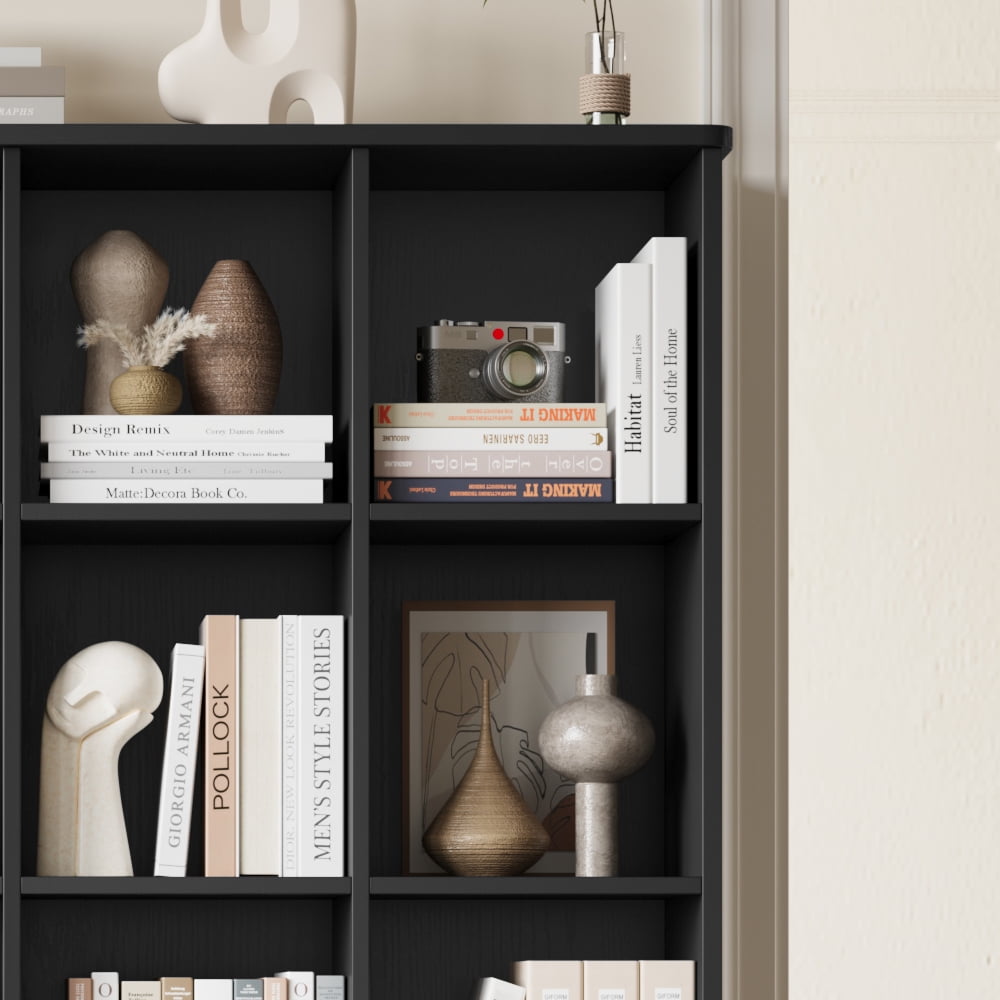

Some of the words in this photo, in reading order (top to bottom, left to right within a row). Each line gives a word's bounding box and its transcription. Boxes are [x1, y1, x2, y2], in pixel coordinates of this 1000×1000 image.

[633, 334, 642, 354] Liess
[664, 328, 678, 370] Home
[633, 355, 642, 385] Lauren
[664, 372, 678, 388] the
[664, 389, 678, 404] of
[520, 408, 536, 421] IT
[538, 408, 596, 421] MAKING
[624, 393, 642, 453] Habitat
[664, 406, 678, 434] Soul
[71, 423, 121, 437] Design
[126, 423, 171, 435] Remix
[482, 433, 525, 444] SAARINEN
[527, 433, 549, 444] EERO
[68, 449, 91, 457] The
[94, 449, 130, 457] White
[133, 449, 153, 457] and
[156, 449, 198, 457] Neutral
[201, 449, 235, 457] Home
[549, 456, 604, 471] Over
[191, 487, 223, 499] Book
[227, 487, 247, 499] Co.
[523, 483, 539, 497] IT
[542, 483, 602, 497] MAKING
[285, 623, 295, 729] REVOLUTION
[313, 627, 332, 717] STORIES
[175, 677, 195, 757] ARMANI
[212, 684, 230, 810] POLLOCK
[285, 734, 295, 780] LOOK
[313, 723, 332, 790] STYLE
[168, 764, 187, 848] GIORGIO
[285, 783, 295, 821] NEW
[313, 795, 332, 861] MEN'S
